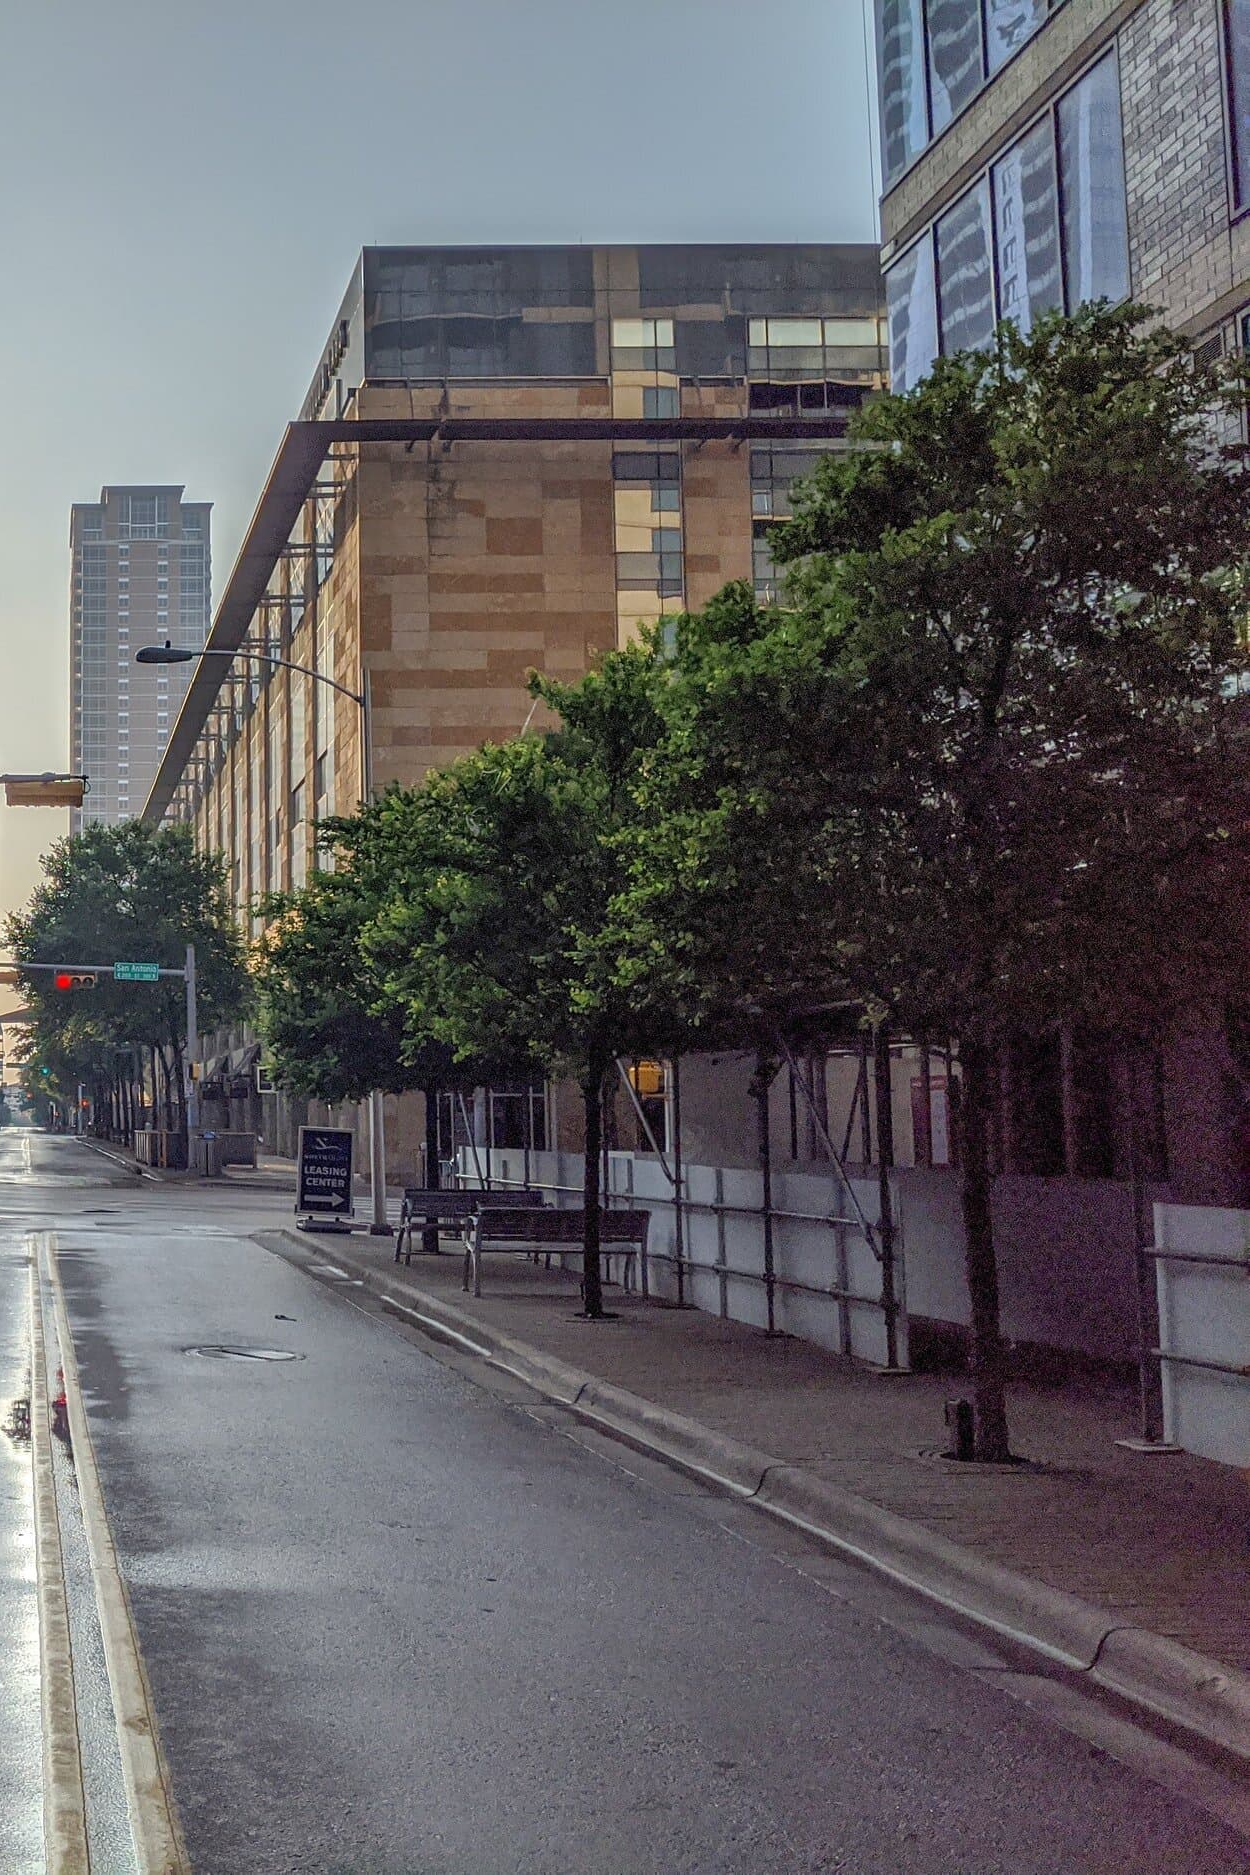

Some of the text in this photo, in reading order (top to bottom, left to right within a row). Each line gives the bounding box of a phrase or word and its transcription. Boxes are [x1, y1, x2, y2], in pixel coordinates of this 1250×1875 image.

[116, 964, 157, 973] San Antonio
[304, 1165, 348, 1177] LEASING
[305, 1177, 345, 1188] CENTER
